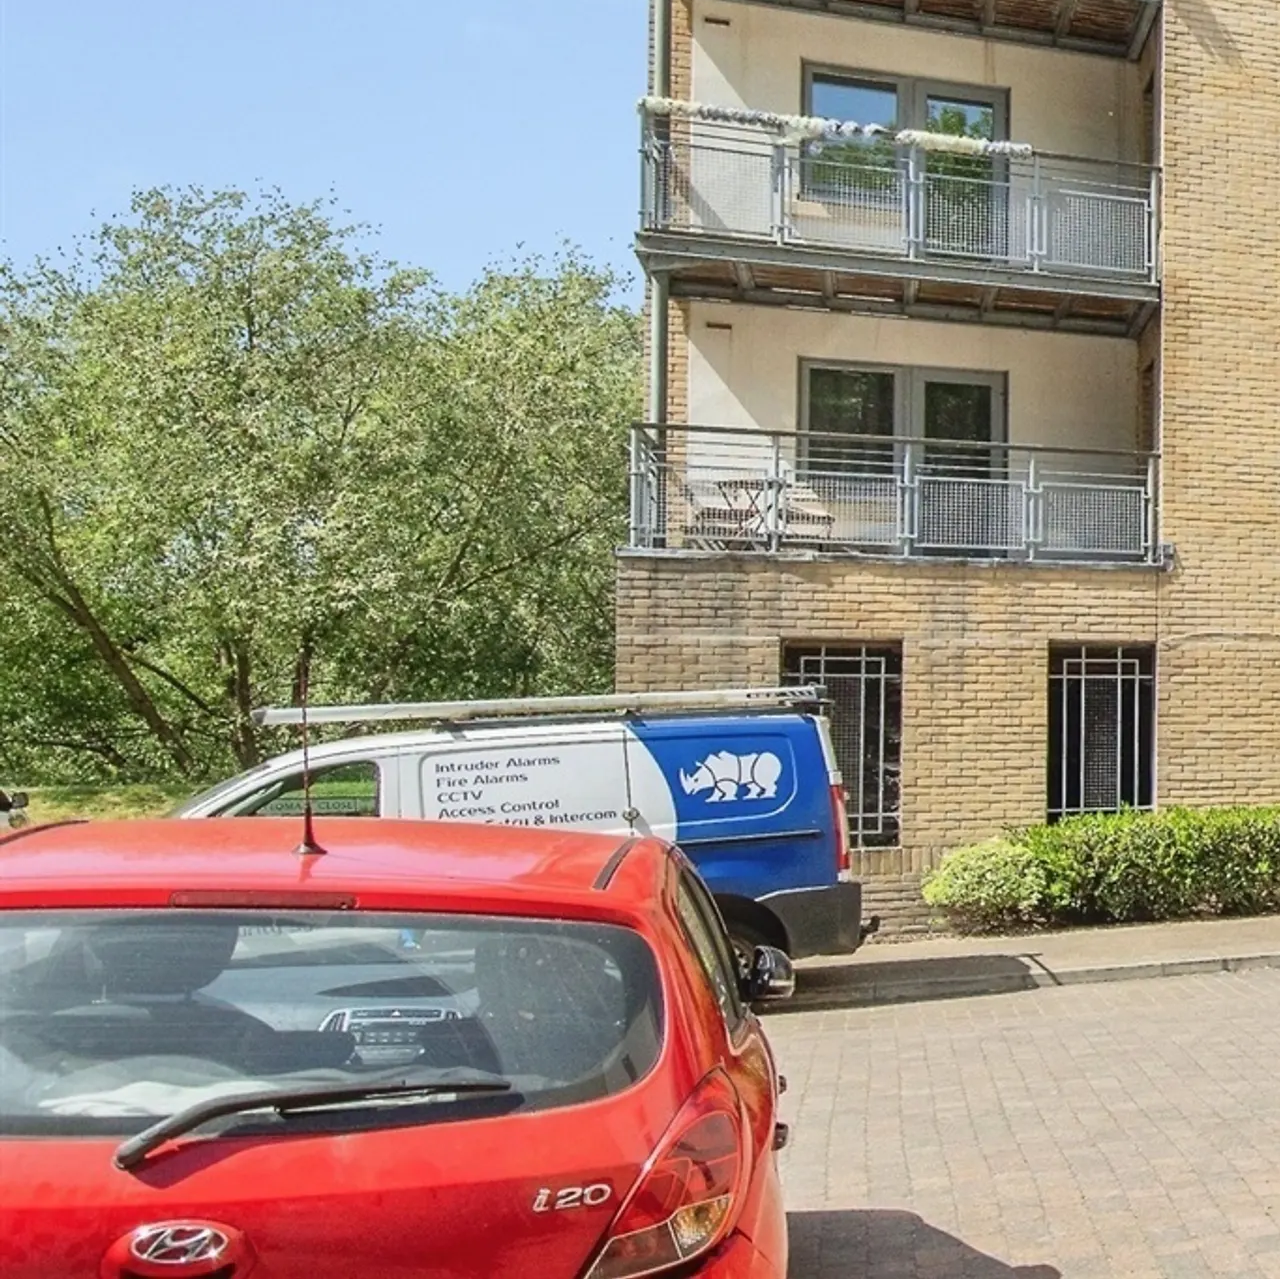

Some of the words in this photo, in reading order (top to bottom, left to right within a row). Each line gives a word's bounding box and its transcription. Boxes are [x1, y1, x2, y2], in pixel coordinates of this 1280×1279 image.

[434, 760, 500, 774] Intruder
[506, 757, 560, 769] Alarms
[436, 777, 468, 789] Fire
[473, 774, 529, 786] Alarms
[317, 800, 354, 811] CLOSE
[437, 790, 483, 804] CCTV
[438, 806, 496, 820] Access
[500, 799, 560, 813] Control
[533, 814, 546, 827] &
[549, 809, 618, 824] Intercom
[532, 1183, 612, 1213] i20
